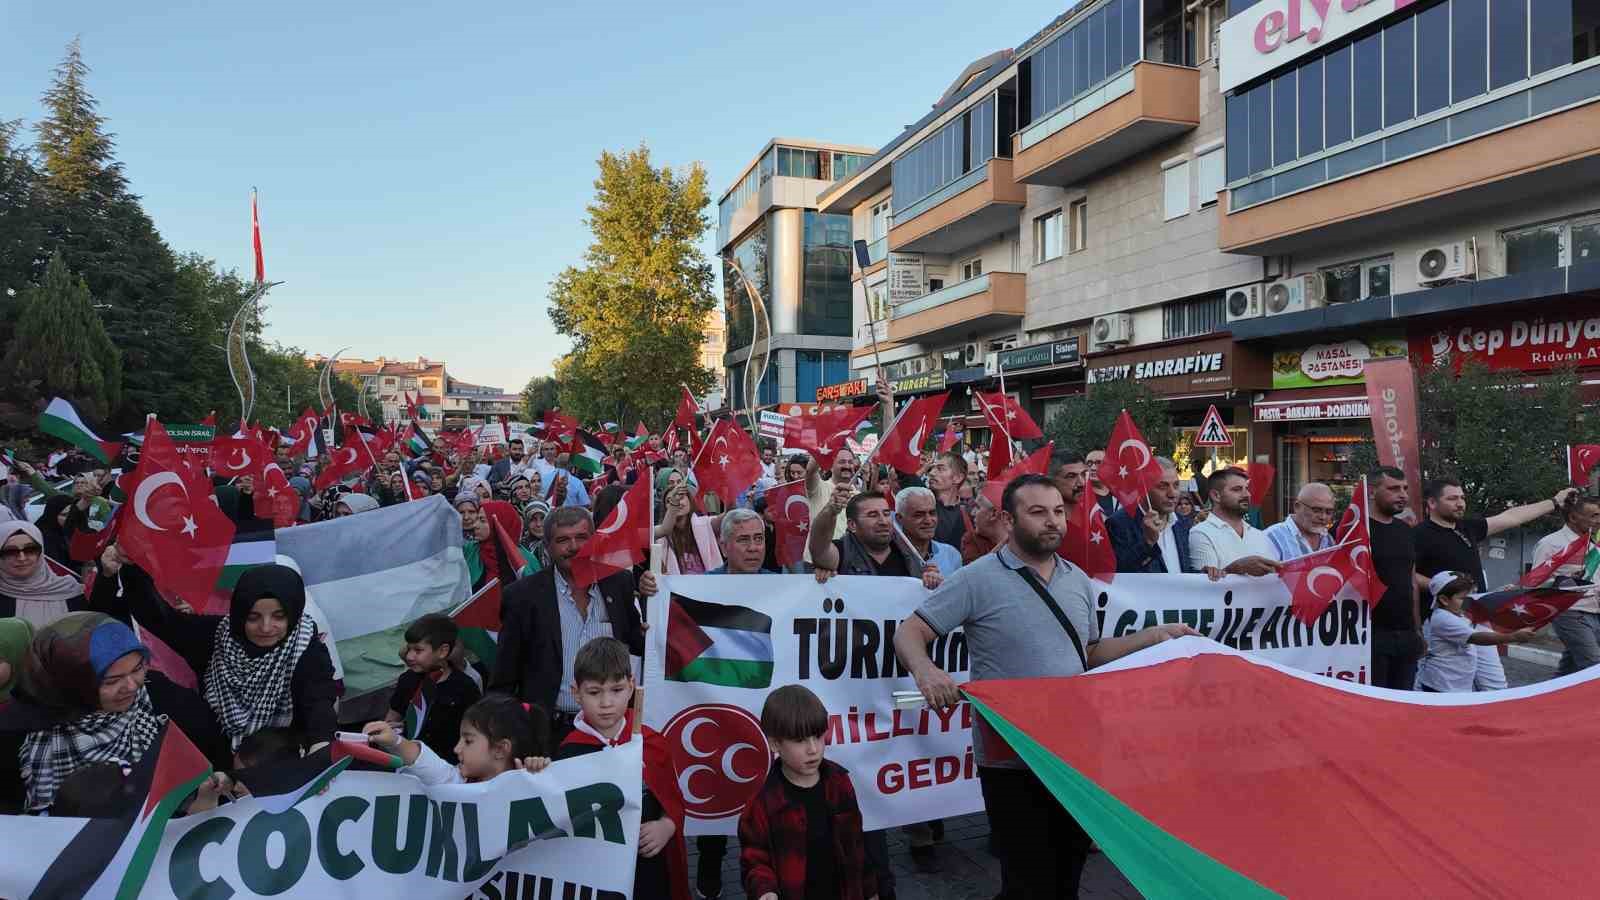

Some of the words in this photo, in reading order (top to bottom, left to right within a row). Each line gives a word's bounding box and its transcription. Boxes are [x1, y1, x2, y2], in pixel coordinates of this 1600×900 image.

[1458, 327, 1504, 356] Cep
[1316, 347, 1352, 361] MASAL
[1587, 347, 1600, 359] A
[1135, 351, 1222, 379] SARRAFİYE
[1327, 402, 1371, 417] DONDURM
[877, 745, 976, 795] GEDİ
